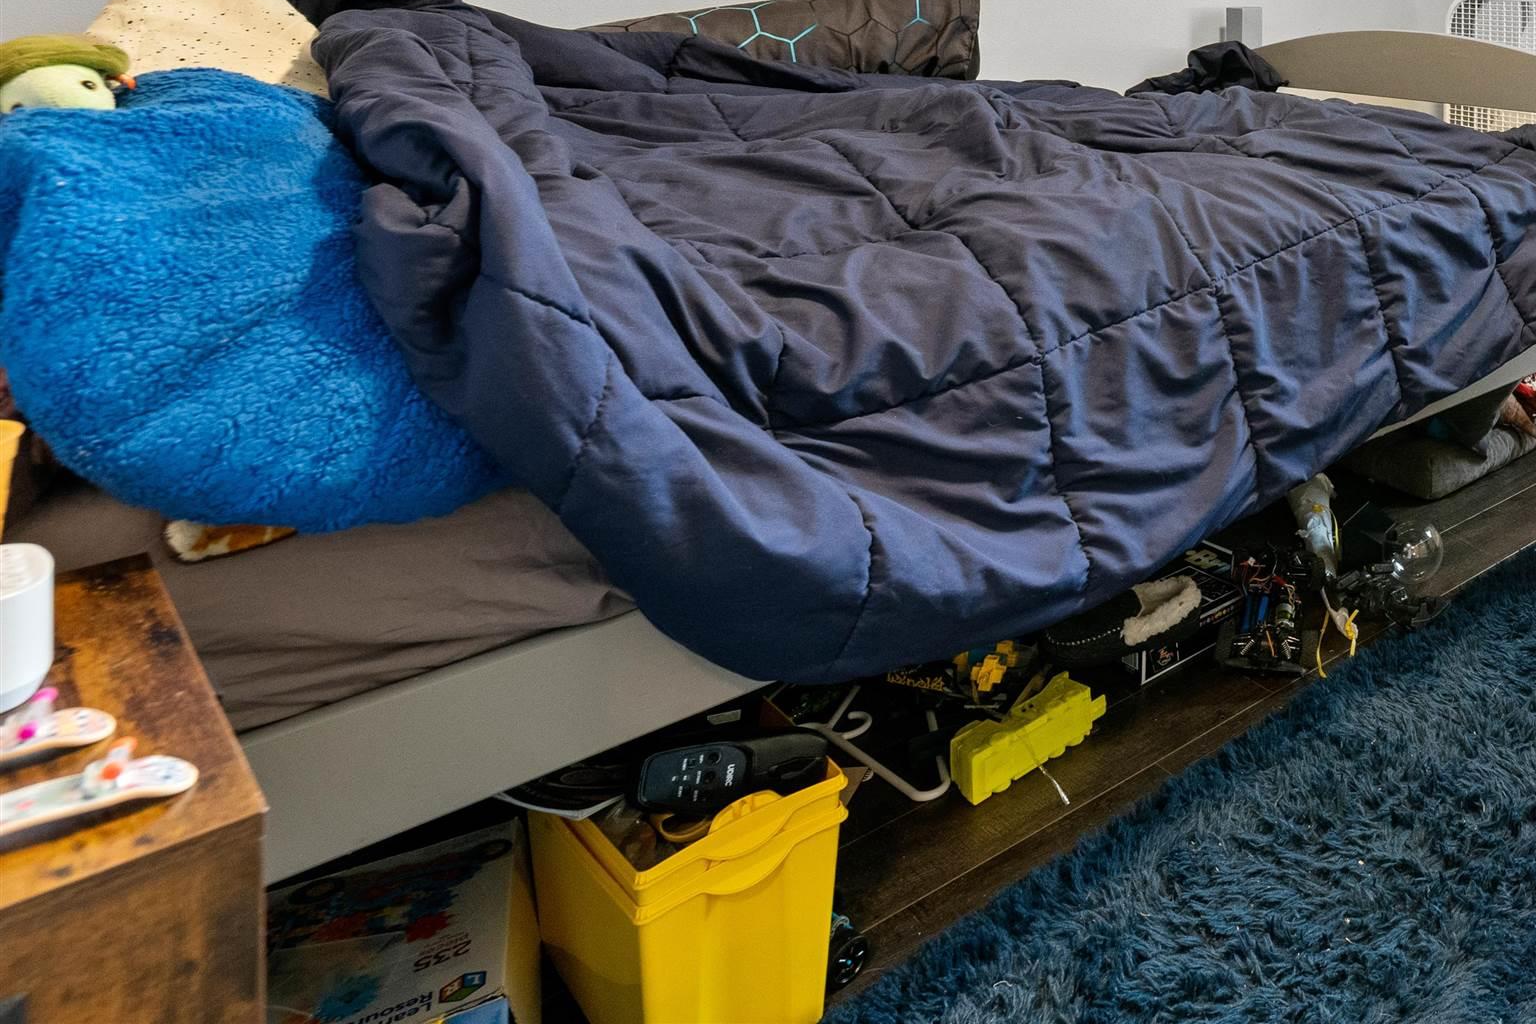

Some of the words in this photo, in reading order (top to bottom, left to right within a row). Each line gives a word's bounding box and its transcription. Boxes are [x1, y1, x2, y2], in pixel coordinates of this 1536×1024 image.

[414, 940, 471, 973] 235
[347, 992, 433, 1024] Resour
[378, 1002, 432, 1024] Lear
